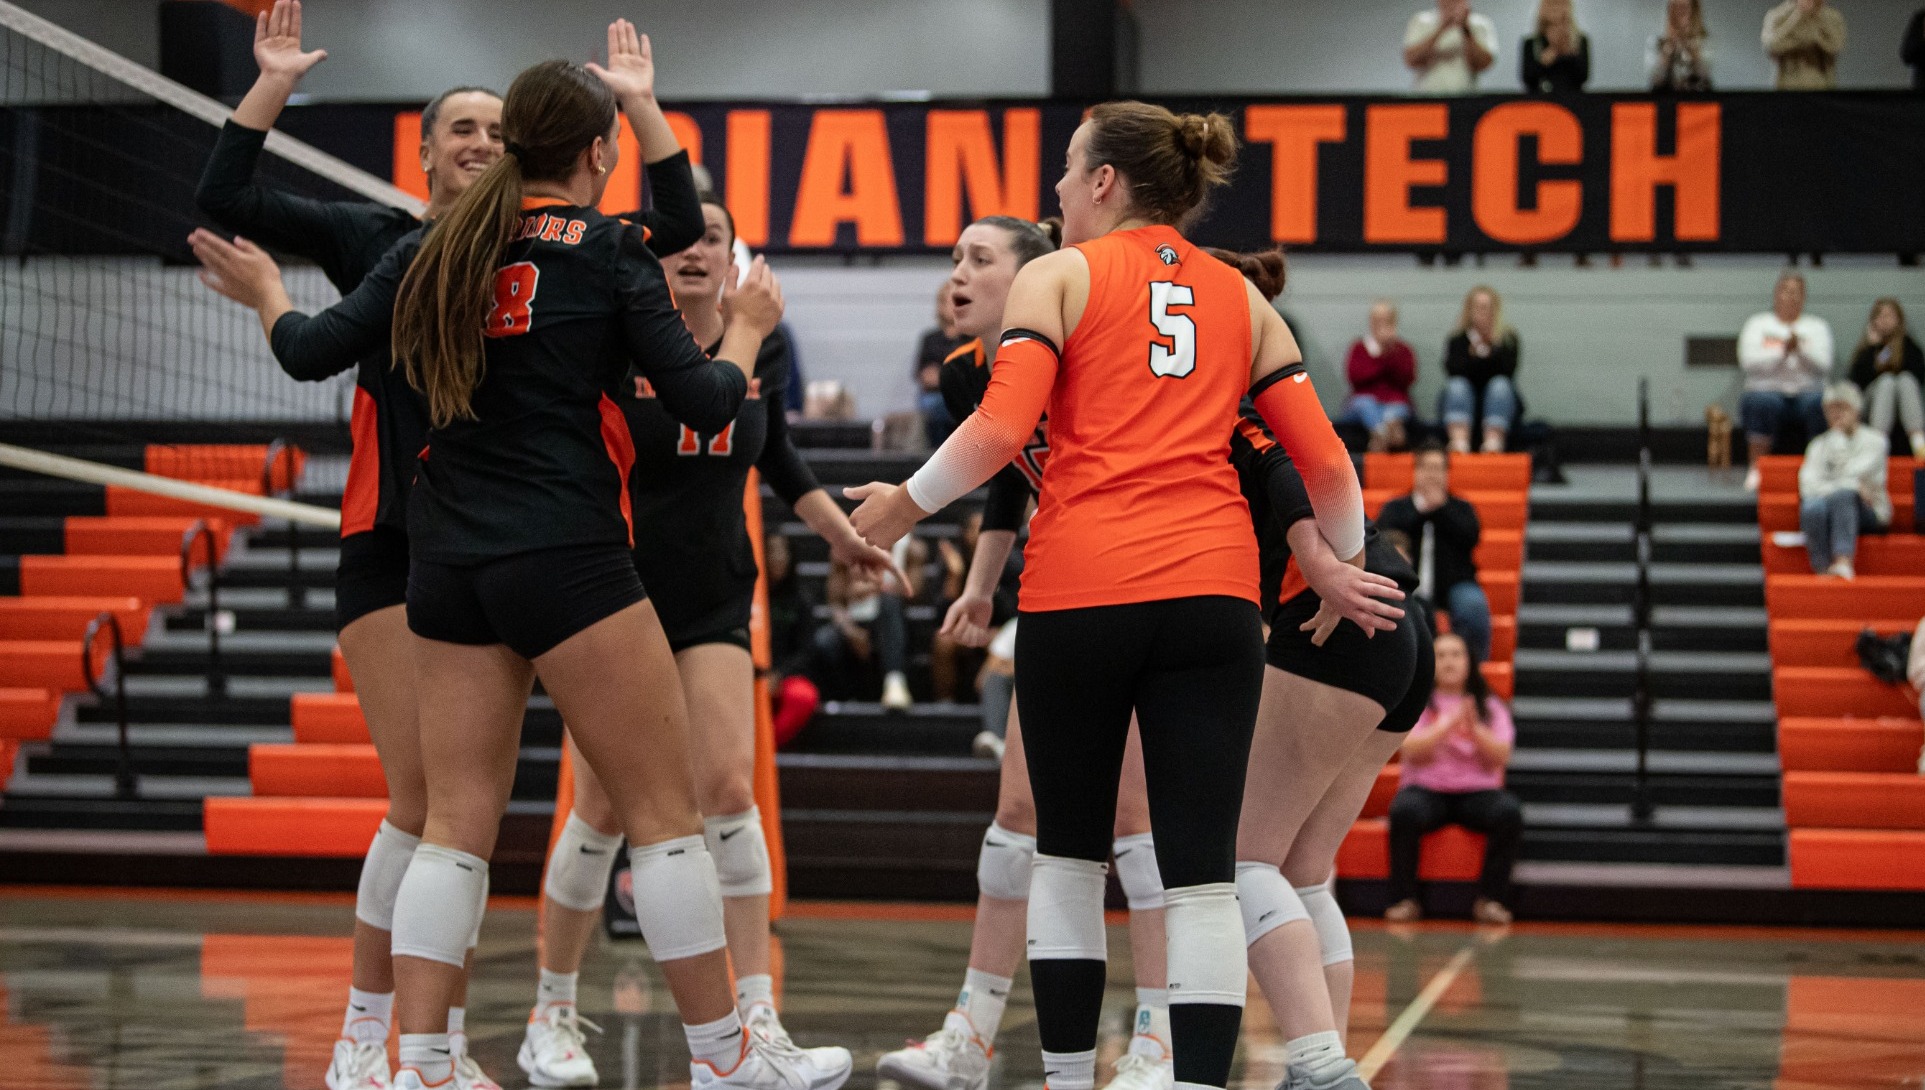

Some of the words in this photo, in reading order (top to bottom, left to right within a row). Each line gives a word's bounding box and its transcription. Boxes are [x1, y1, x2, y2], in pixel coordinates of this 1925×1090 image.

[1244, 101, 1722, 244] TECH
[484, 260, 540, 339] 8
[1148, 279, 1196, 380] 5
